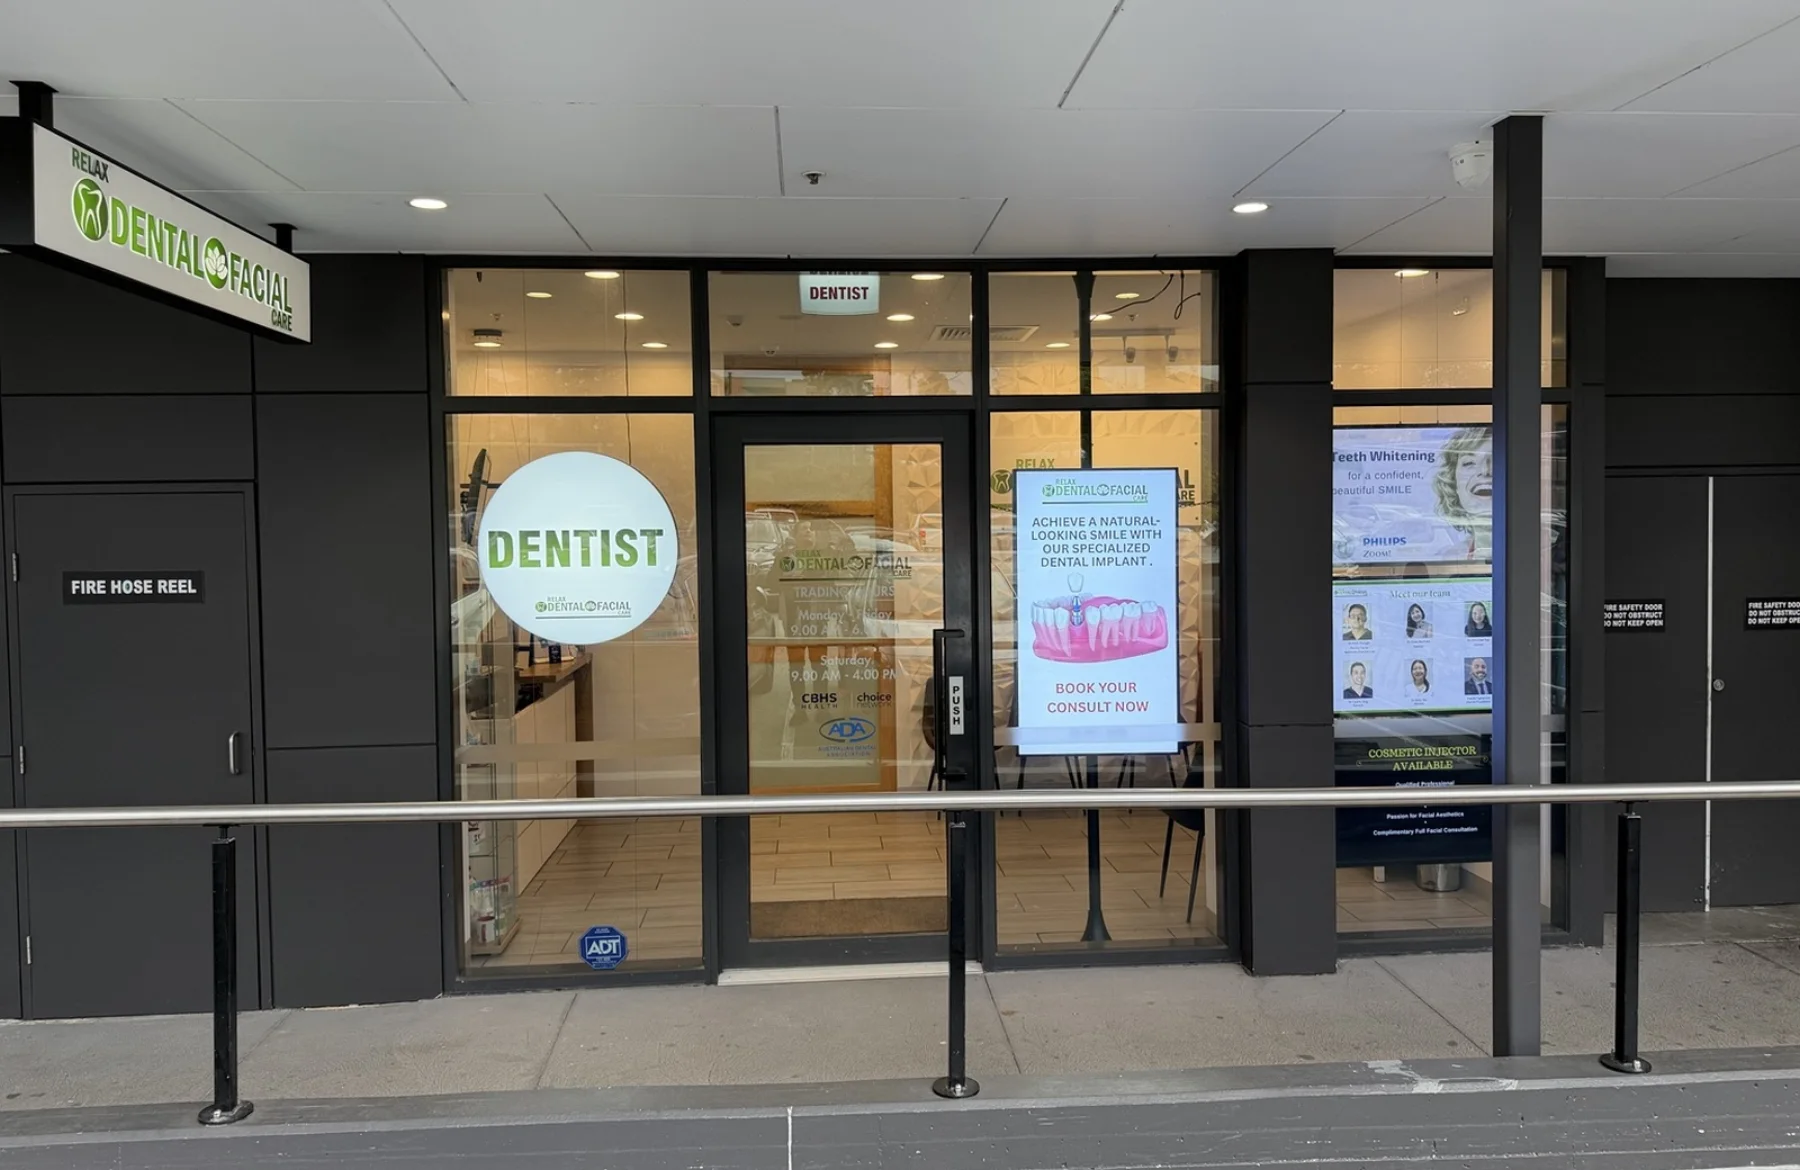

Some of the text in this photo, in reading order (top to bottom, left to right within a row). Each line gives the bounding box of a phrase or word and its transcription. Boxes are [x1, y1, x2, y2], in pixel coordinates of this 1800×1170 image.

[72, 147, 109, 183] RELAX
[109, 196, 292, 313] DENTAL FACIAL
[810, 287, 869, 300] DENTIST
[271, 311, 292, 331] CARE
[1370, 450, 1435, 463] Whitening
[1016, 459, 1055, 468] RELAX
[1348, 470, 1424, 480] for a confident,
[1056, 484, 1148, 496] DENTAL FACIAL
[1379, 485, 1411, 494] SMILE
[1032, 516, 1160, 527] ACHIEVE A NATURAL-
[1031, 529, 1162, 541] LOOKING SMILE WITH
[1363, 536, 1406, 546] PHILIPS
[488, 528, 664, 569] DENTIST
[1042, 543, 1151, 554] OUR SPECIALIZED
[797, 556, 912, 570] DENTAL FACIAL
[1041, 557, 1089, 567] DENTAL
[1092, 556, 1147, 567] IMPLANT
[893, 569, 912, 577] CARE
[71, 579, 197, 594] FIRE HOSE REEL
[548, 601, 631, 611] DENTAL FACIAL
[1619, 603, 1644, 611] SAFETY
[1645, 603, 1663, 611] DOOR
[798, 608, 845, 622] Monday
[1628, 611, 1663, 619] OBSTRUCT
[1646, 619, 1664, 627] OPEN
[791, 624, 818, 636] 9.00
[791, 670, 818, 681] 9.00
[821, 669, 841, 681] AM
[852, 669, 879, 680] 4.00
[1056, 682, 1137, 694] BOOK YOUR
[801, 691, 892, 703] CBHS choice
[952, 685, 961, 726] PUSH
[1047, 701, 1149, 713] CONSULT NOW
[828, 722, 866, 737] ADA
[1368, 746, 1477, 759] COSMETIC INJECTOR
[1393, 760, 1453, 771] AVAILABLE
[587, 940, 620, 955] ADT
